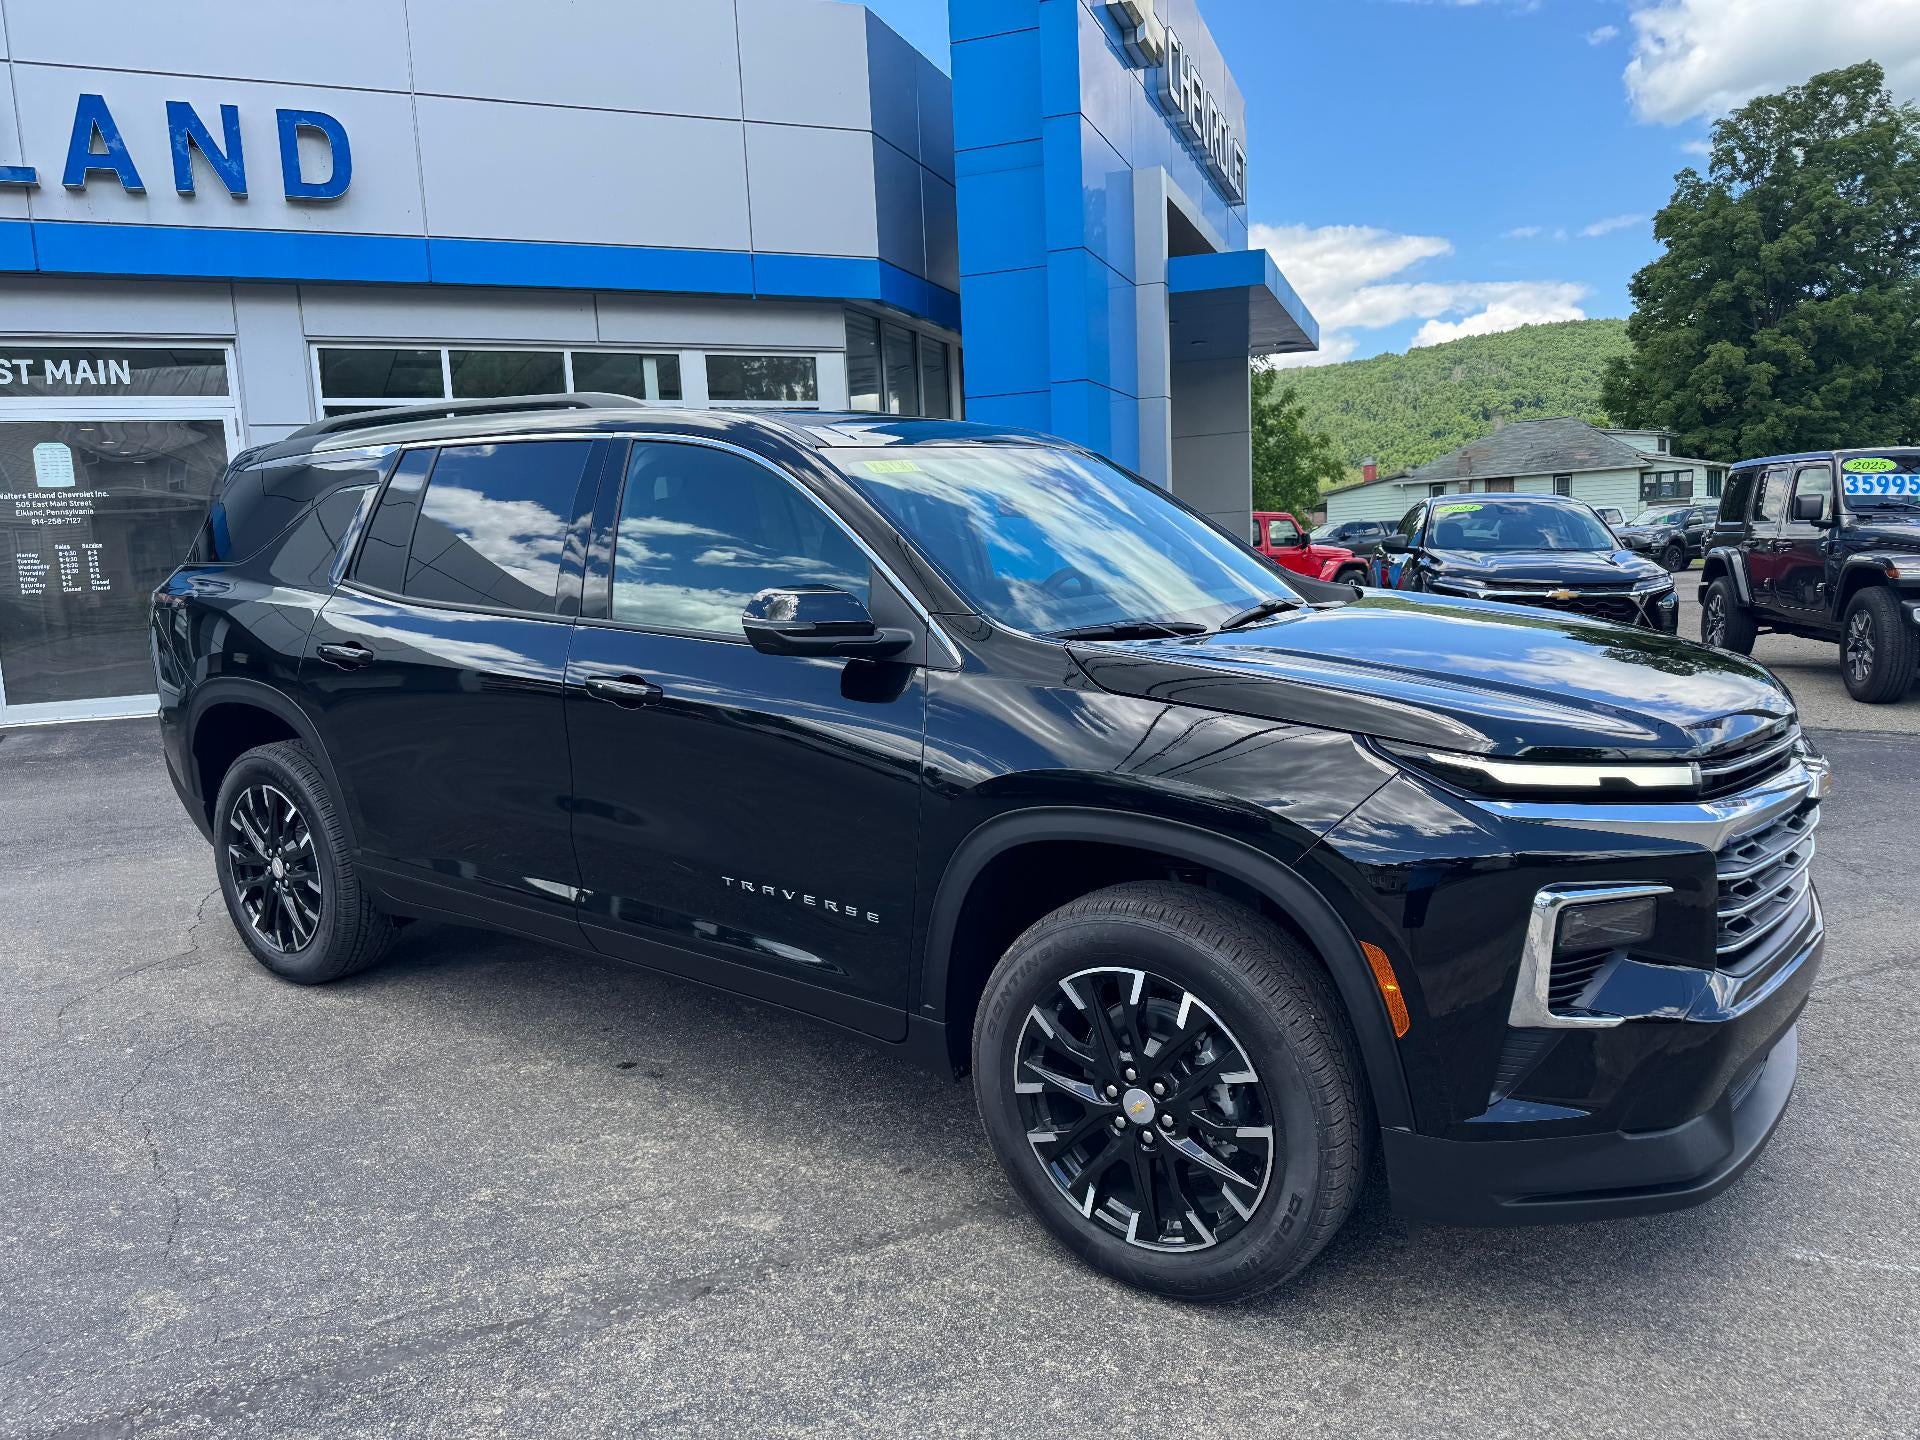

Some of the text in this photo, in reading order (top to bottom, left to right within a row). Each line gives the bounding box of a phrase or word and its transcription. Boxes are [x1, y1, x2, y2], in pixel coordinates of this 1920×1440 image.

[1165, 26, 1247, 204] CHEVROLET
[44, 358, 131, 385] MAIN
[1853, 461, 1887, 470] 2025
[1845, 475, 1920, 495] 35995
[28, 491, 55, 499] Elkland
[57, 491, 94, 499] Chevrolet
[69, 499, 92, 507] Street
[15, 508, 94, 517] Elkland, Pennsylvania
[721, 875, 880, 924] TRAVERSE
